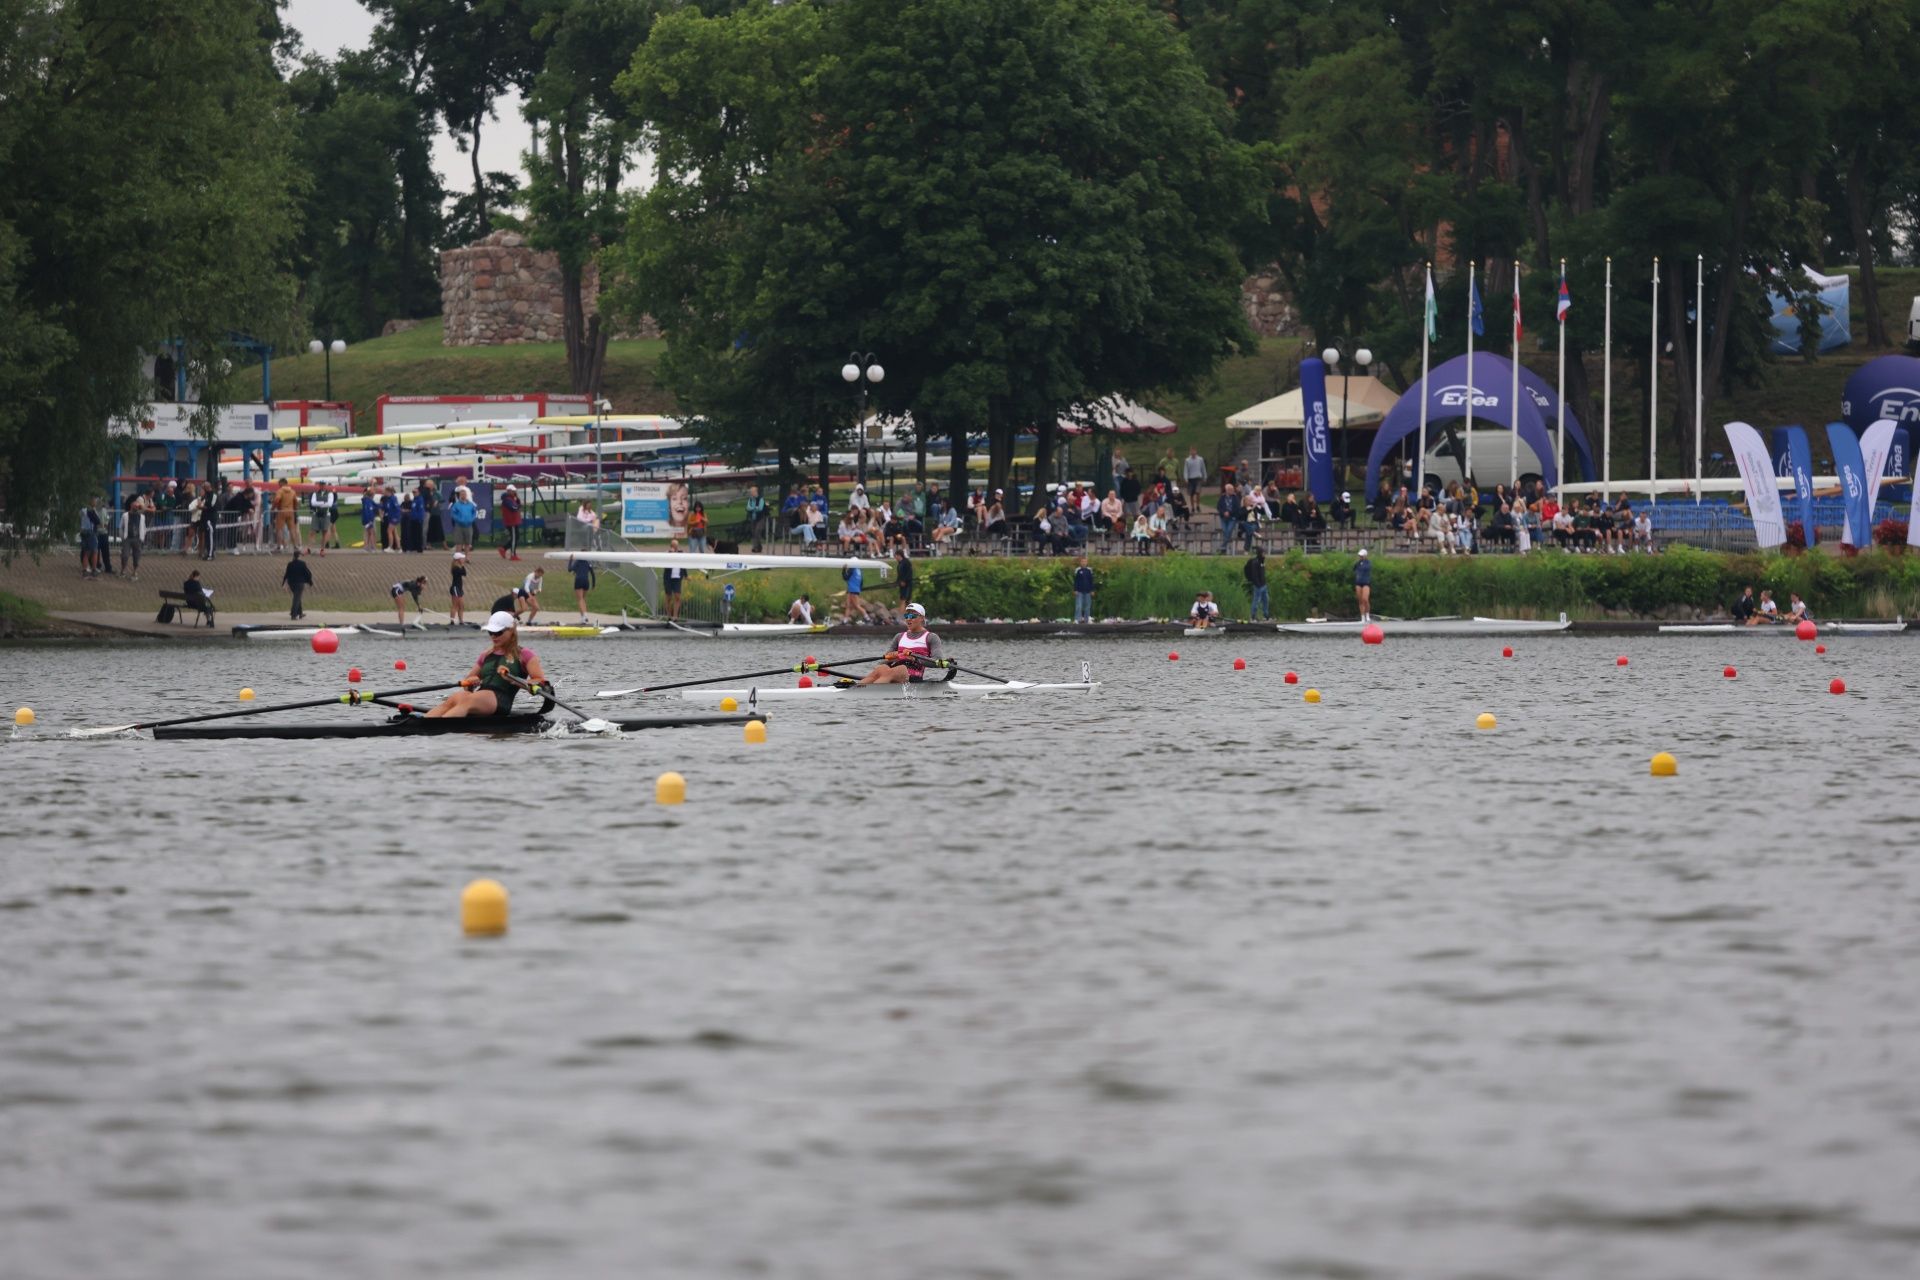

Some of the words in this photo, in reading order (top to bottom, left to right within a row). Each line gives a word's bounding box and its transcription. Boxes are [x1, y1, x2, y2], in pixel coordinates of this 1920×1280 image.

[1312, 401, 1327, 454] Enea
[1083, 662, 1091, 680] 3
[748, 686, 757, 708] 4
